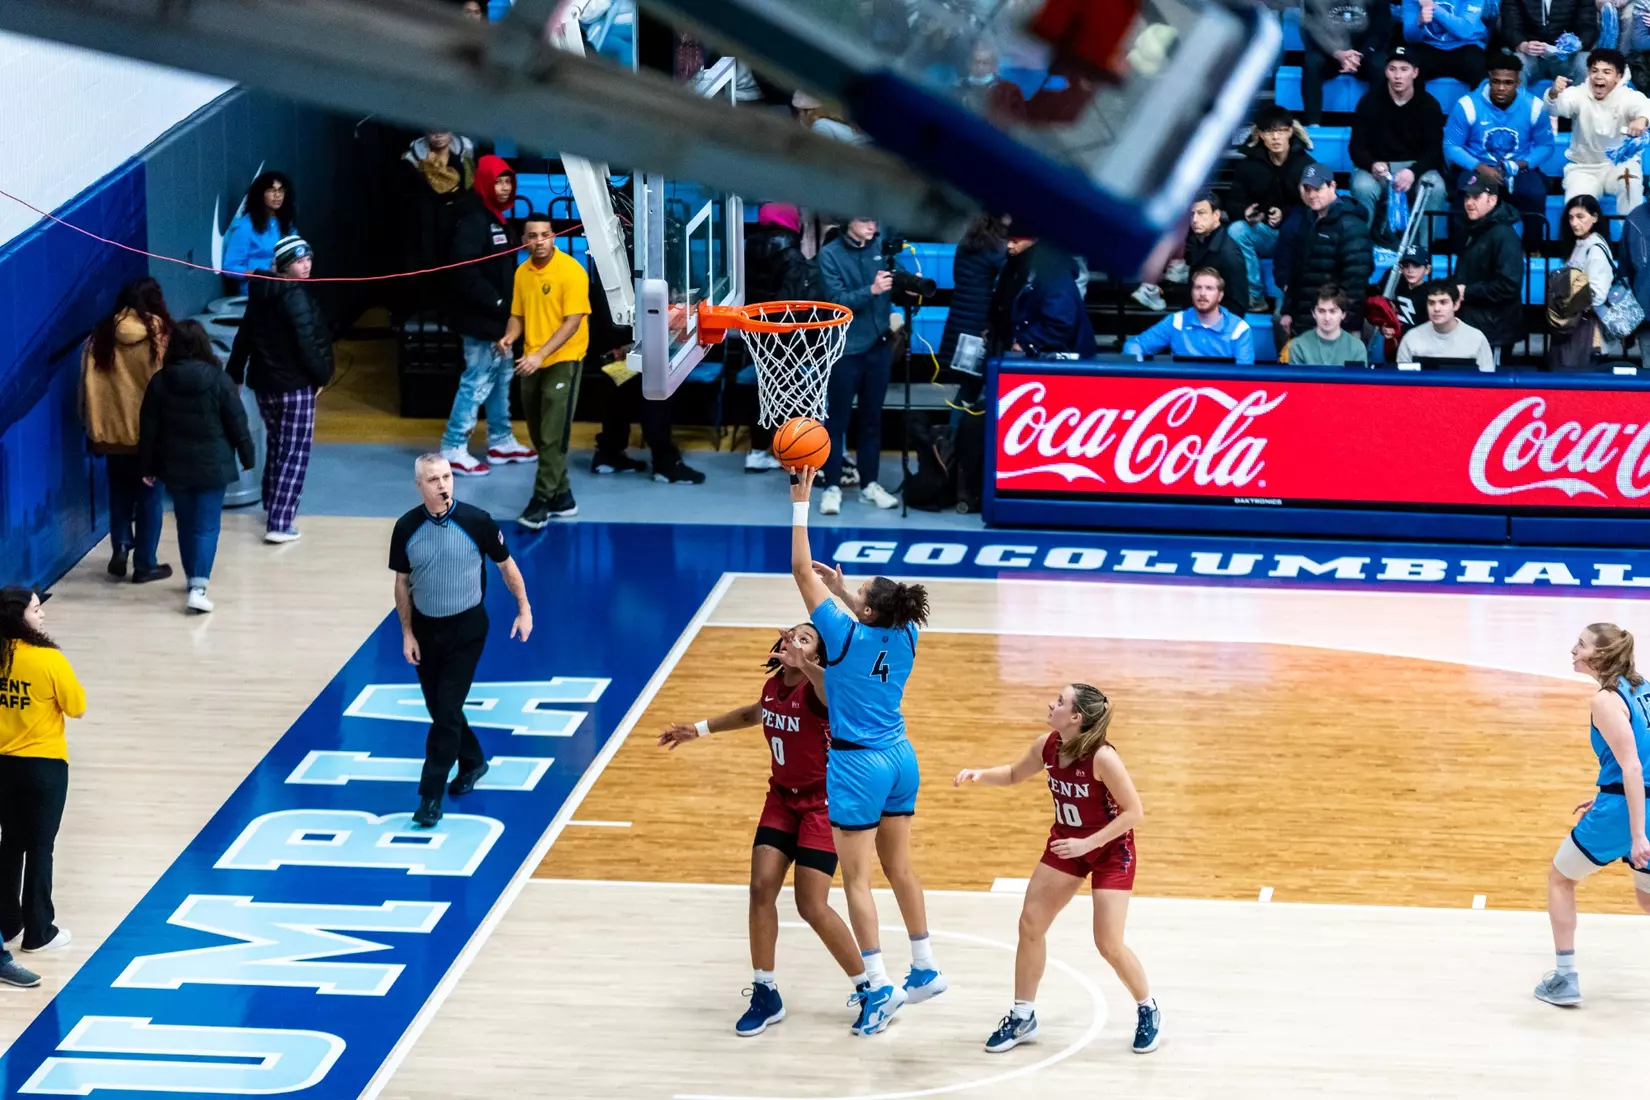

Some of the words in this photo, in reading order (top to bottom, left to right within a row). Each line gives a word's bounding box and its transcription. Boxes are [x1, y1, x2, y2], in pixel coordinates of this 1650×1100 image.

[996, 381, 1288, 487] Coca-Cola
[869, 650, 890, 683] 4
[761, 708, 800, 732] PENN
[771, 736, 785, 766] 0
[1054, 798, 1083, 827] 10
